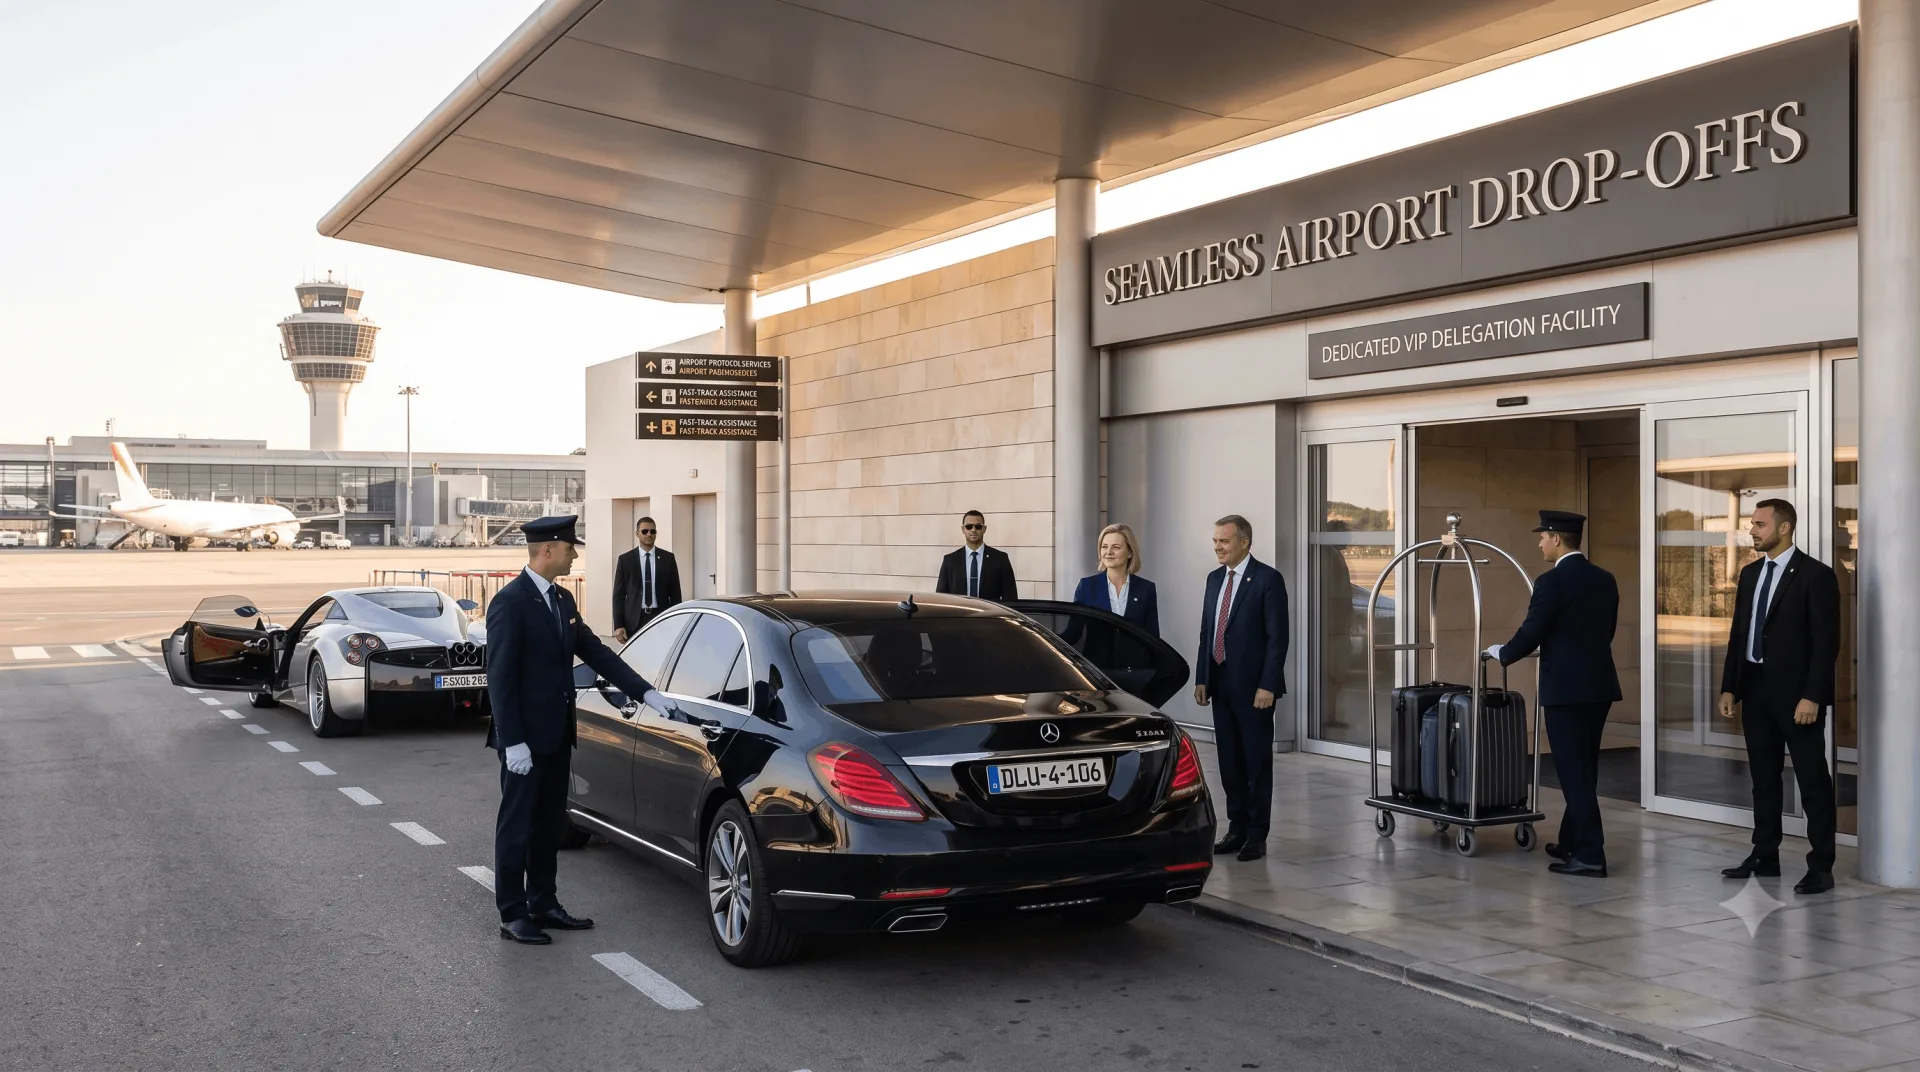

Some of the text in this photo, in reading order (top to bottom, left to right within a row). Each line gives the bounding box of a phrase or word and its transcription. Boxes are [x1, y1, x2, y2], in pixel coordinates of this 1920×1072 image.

[1104, 101, 1804, 306] SEAMLESS AIRPORT DROP-OFFS
[1322, 303, 1621, 363] DEDICATED VIP DELEGATION FACILITY
[679, 358, 707, 366] AIRPORT
[679, 388, 758, 398] FAST-TRACK ASSISTANCE
[718, 399, 758, 407] ASSISTANCE
[679, 418, 758, 428] FAST-TRACK ASSISTANCE
[679, 428, 758, 437] FAST-TRACK ASSISTANCE
[1000, 761, 1101, 789] DLU-4-106
